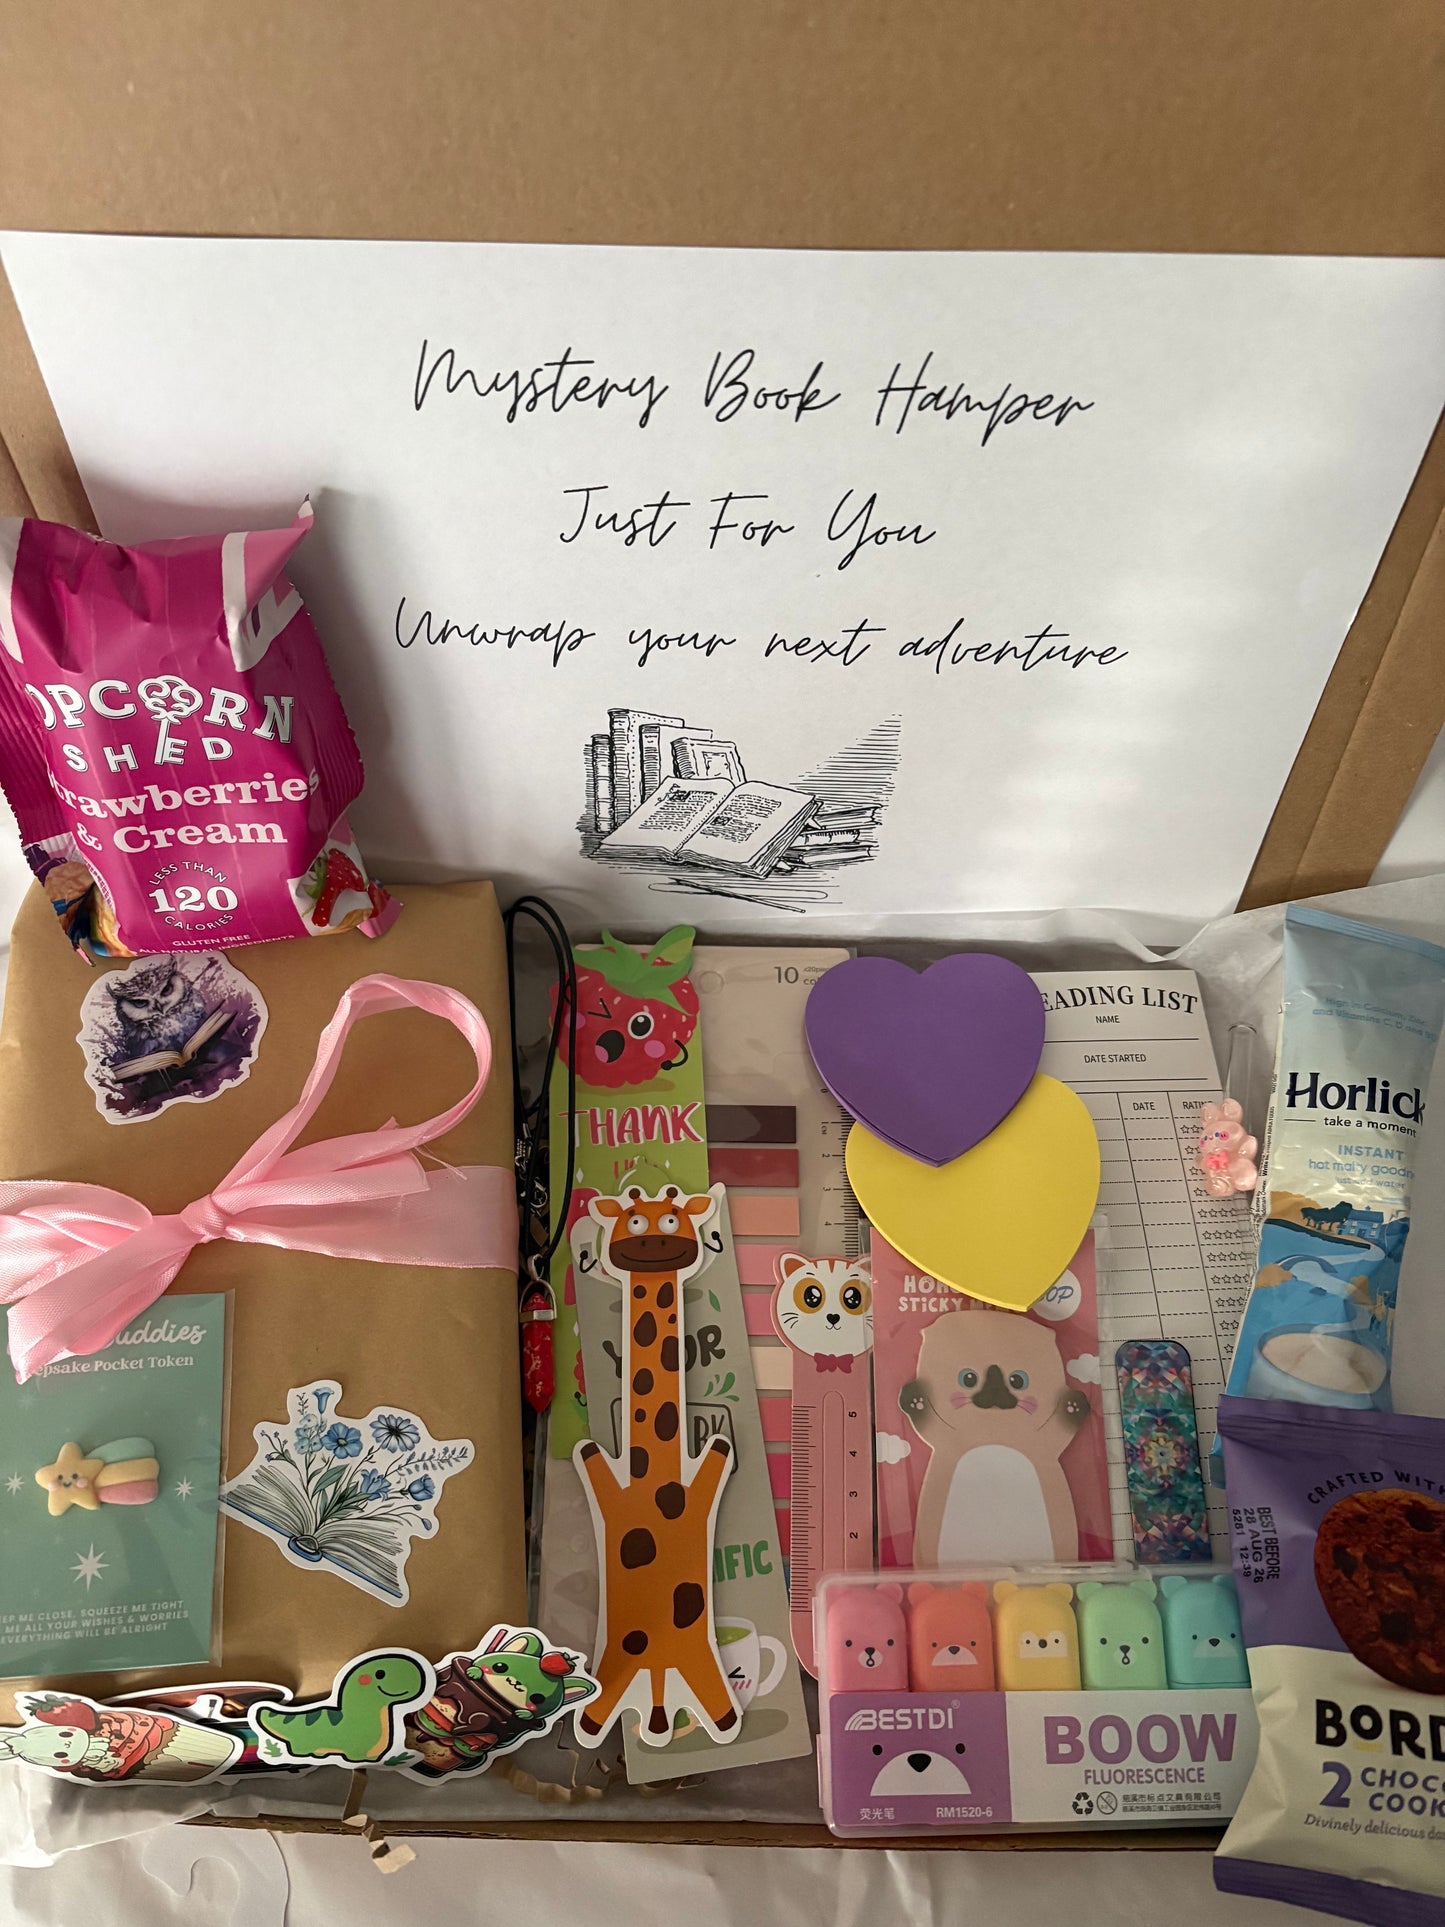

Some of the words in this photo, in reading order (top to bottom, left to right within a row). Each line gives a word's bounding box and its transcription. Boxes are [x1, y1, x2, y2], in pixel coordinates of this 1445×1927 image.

[414, 339, 668, 428] Mystery
[705, 348, 841, 423] Book
[875, 351, 1095, 446] Hamper
[559, 486, 691, 547] Just
[709, 494, 795, 549] For
[826, 488, 937, 570] You
[395, 597, 596, 667] Unwrap
[627, 621, 737, 666] your
[765, 626, 886, 666] next
[898, 618, 1129, 675] adventure
[61, 736, 234, 773] SHED
[48, 767, 321, 820] trawberries
[76, 822, 103, 852] &
[113, 822, 288, 854] Cream
[149, 863, 179, 886] LESS
[182, 861, 228, 883] THAN
[148, 886, 239, 913] 120
[164, 913, 234, 931] CALORIES
[172, 939, 221, 947] GLUTEN
[223, 934, 251, 944] FREE
[773, 966, 799, 984] 10
[1040, 985, 1134, 1012] EADING
[1141, 986, 1198, 1014] LIST
[1095, 1014, 1120, 1024] NAME
[1084, 1054, 1106, 1064] DATE
[1108, 1053, 1147, 1063] STARTED
[1132, 1101, 1156, 1111] DATE
[557, 1101, 705, 1148] THANK
[1324, 1116, 1352, 1127] take
[1355, 1119, 1363, 1128] a
[1367, 1121, 1417, 1138] moment
[1308, 1159, 1330, 1171] hot
[1338, 1145, 1405, 1161] INSTANT
[103, 1320, 206, 1350] uddies
[36, 1361, 91, 1378] epsake
[93, 1357, 144, 1372] Pocket
[148, 1355, 194, 1368] Token
[849, 1490, 858, 1498] 3
[1307, 1471, 1384, 1504] CRAFTED
[1244, 1508, 1257, 1524] 28
[1257, 1507, 1277, 1535] BEST
[1248, 1528, 1262, 1562] AUG
[713, 1540, 772, 1582] IFIC
[1264, 1537, 1280, 1579] BEFORE
[1254, 1568, 1264, 1583] 26
[5, 1625, 21, 1634] ME
[25, 1623, 43, 1632] ALL
[47, 1620, 78, 1630] YOUR
[81, 1616, 124, 1628] WISHES
[127, 1615, 135, 1624] &
[139, 1609, 189, 1623] WORRIES
[18, 1614, 34, 1622] ME
[80, 1604, 129, 1617] SQUEEZE
[131, 1603, 147, 1612] ME
[151, 1600, 184, 1610] TIGHT
[1, 1632, 71, 1645] EVERYTHING
[75, 1629, 100, 1639] WILL
[103, 1627, 118, 1636] BE
[121, 1621, 169, 1635] ALRIGHT
[844, 1708, 954, 1731] BESTDI
[1043, 1713, 1238, 1765] BOOW
[1084, 1767, 1206, 1785] FLUORESCENCE
[1319, 1760, 1352, 1808] 2
[1360, 1766, 1445, 1792] CHOC
[936, 1807, 993, 1818] RM1520-6
[1304, 1814, 1361, 1835] Divinely
[1365, 1820, 1425, 1840] delicious
